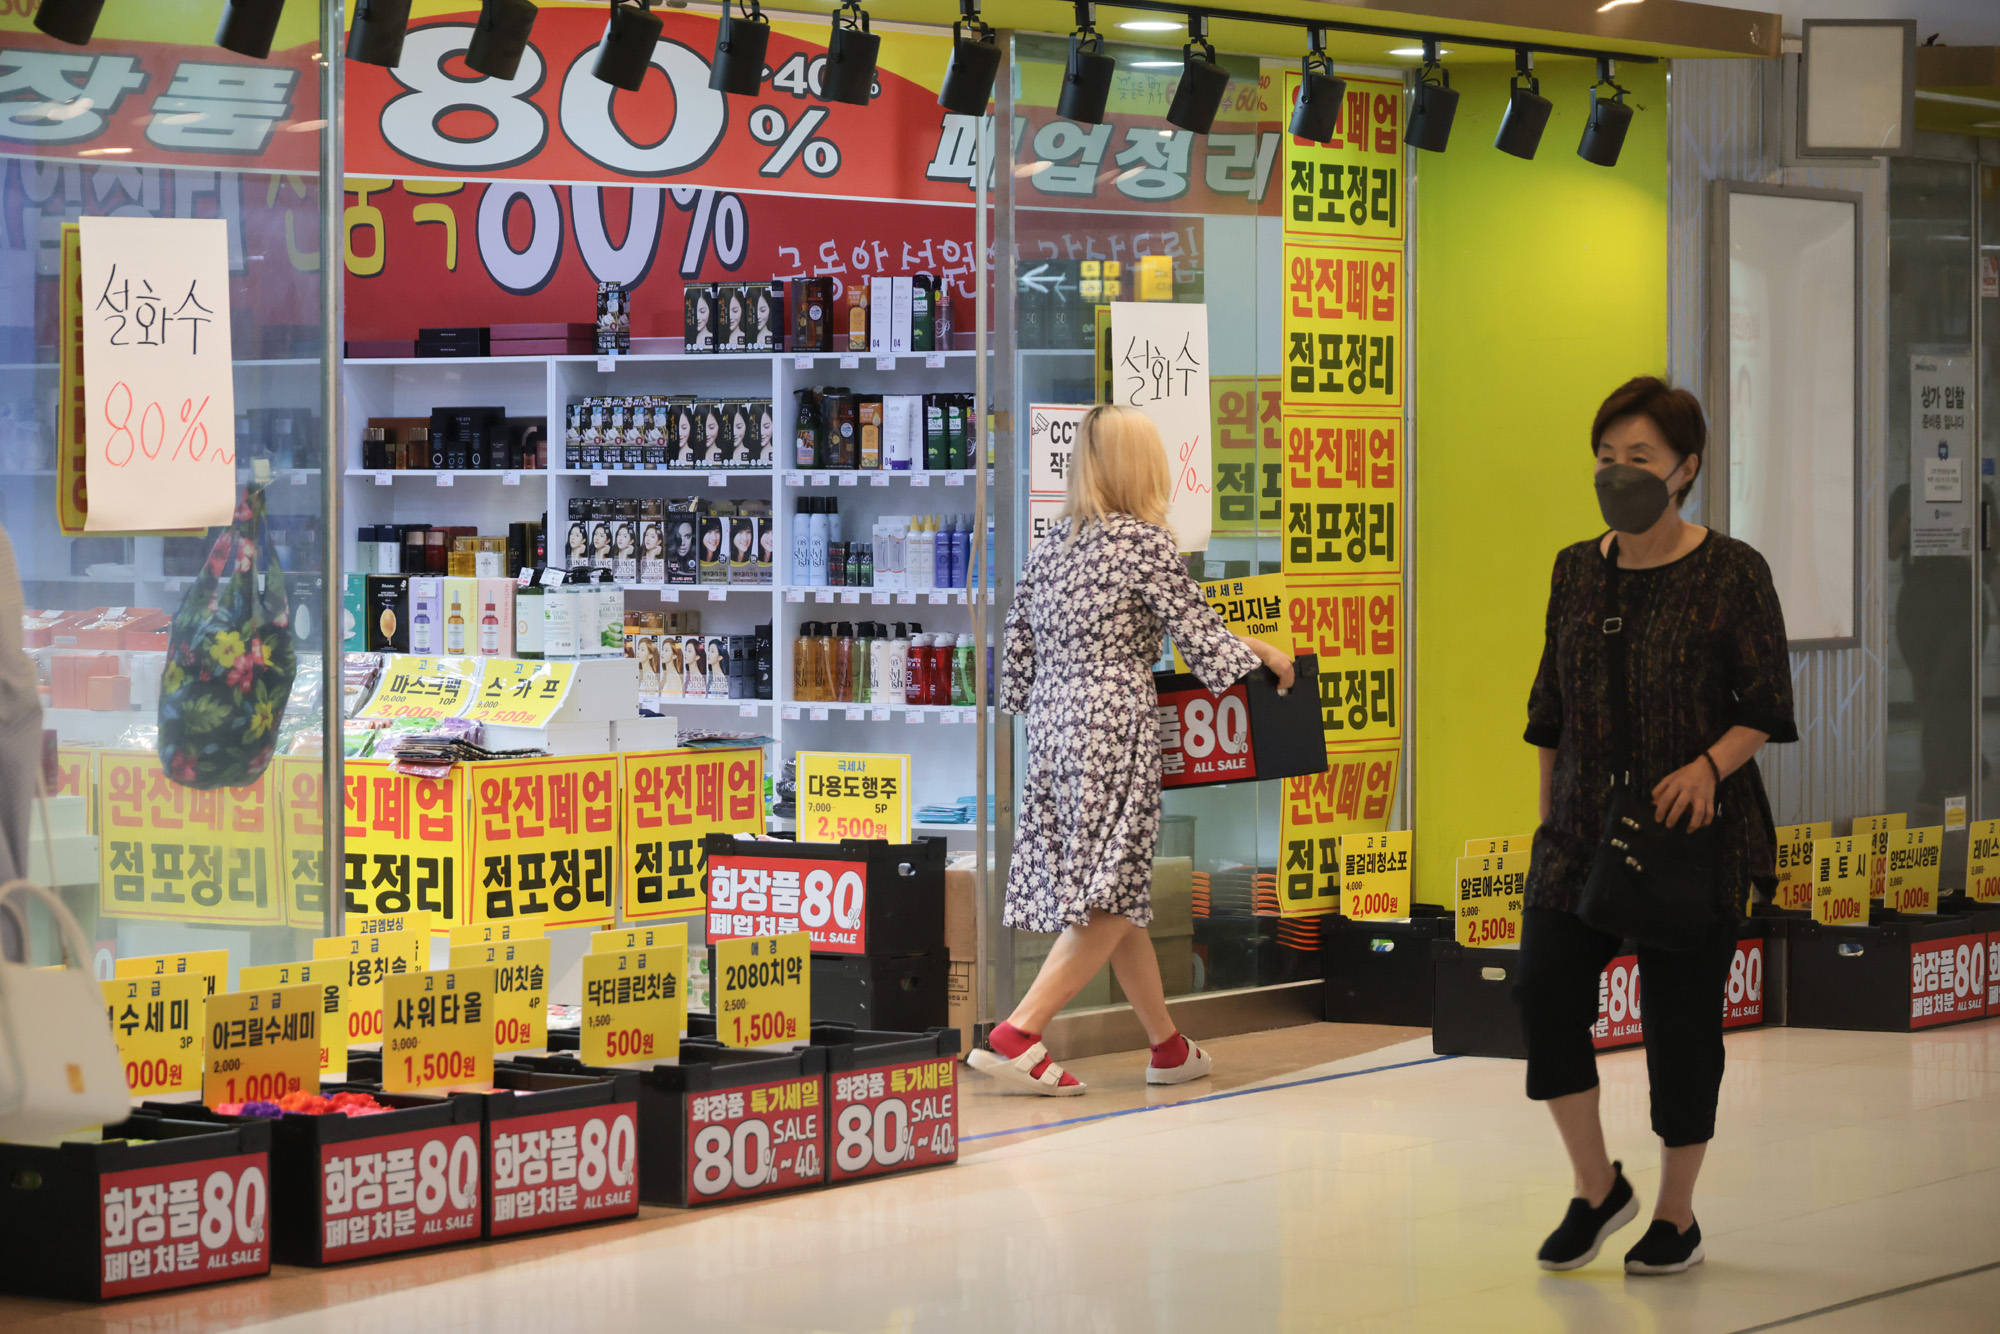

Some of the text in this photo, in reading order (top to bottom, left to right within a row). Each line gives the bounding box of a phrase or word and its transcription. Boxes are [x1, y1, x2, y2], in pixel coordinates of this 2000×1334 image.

[1291, 85, 1398, 154] 폐업
[926, 114, 1281, 203] 폐업정리
[1290, 161, 1396, 227] 점포정리
[1290, 256, 1395, 321] 완전폐업
[96, 264, 214, 354] 설화수
[873, 339, 880, 348] 04
[893, 339, 901, 347] 04
[1120, 331, 1200, 407] 설화수
[1289, 332, 1394, 394] 점포정리
[1921, 385, 1965, 409] 상가 입찰
[1944, 415, 1965, 430] 입니다
[1288, 427, 1394, 489] 완전폐업
[1288, 502, 1394, 563] 점포정리
[1205, 582, 1244, 599] 바세린
[1212, 595, 1282, 623] 오리지날
[1246, 621, 1279, 636] 100ml
[1289, 595, 1394, 657] 완전폐업
[390, 674, 462, 697] 마스크팩
[485, 677, 560, 699] 스카프
[1317, 668, 1395, 730] 포정리
[379, 694, 457, 706] 10,000 10P
[476, 700, 499, 709] 9,000
[474, 710, 537, 724] 2,500원
[1183, 694, 1249, 759] 80%
[837, 760, 866, 772] 극세사
[1193, 757, 1247, 774] ALL SALE
[108, 764, 265, 833] 완전폐업
[633, 760, 756, 829] 완전폐업
[808, 775, 898, 799] 다용도행주
[1289, 761, 1393, 826] 완전폐업
[480, 770, 613, 841] 완전폐업
[807, 802, 888, 814] 7,000 5P
[817, 816, 888, 840] 2,500원
[1794, 827, 1811, 839] 고급
[1872, 818, 1887, 830] 고급
[1907, 831, 1924, 844] 고급
[1367, 835, 1387, 848] 고급
[1489, 840, 1509, 853] 고급
[1835, 840, 1852, 853] 고급
[634, 837, 709, 904] 점포
[1286, 835, 1342, 900] 점포
[1345, 851, 1407, 876] 물걸레청소포
[1483, 857, 1503, 871] 고급
[1820, 853, 1866, 882] 쿨토시
[1890, 845, 1939, 871] 양모신사양말
[109, 841, 269, 908] 점포정리
[483, 845, 613, 918] 점포정리
[1345, 881, 1363, 891] 4,000
[1460, 872, 1524, 900] 알로에수딩젤
[710, 865, 864, 930] 화장품 80%
[1352, 892, 1398, 919] 2,000원
[1461, 900, 1522, 917] 5,000 99%
[1823, 897, 1861, 923] 1,000원
[1895, 887, 1929, 912] 1,000원
[360, 917, 404, 934] 고급엠보싱
[483, 925, 511, 942] 고급
[709, 912, 857, 945] 폐업처분 ALL SALE
[1468, 917, 1515, 945] 2,500원
[350, 938, 379, 954] 고급
[626, 931, 654, 948] 고급
[751, 940, 777, 956] 애경
[155, 958, 187, 974] 고급
[485, 946, 515, 962] 고급
[618, 953, 647, 970] 고급
[280, 966, 311, 984] 고급
[424, 974, 456, 991] 고급
[494, 963, 544, 994] 어칫솔
[726, 956, 802, 991] 2080치약
[1728, 947, 1762, 1004] 80%
[1912, 949, 1954, 994] 화장품
[127, 981, 161, 998] 고급
[249, 993, 281, 1011] 고급
[587, 972, 677, 1007] 닥터클린칫솔
[1608, 963, 1641, 1023] 80
[393, 991, 482, 1030] 샤워타올
[528, 997, 540, 1010] 4P
[724, 998, 747, 1012] 2,500
[1731, 1005, 1760, 1018] ALL SALE
[1912, 991, 1982, 1018] 폐업처분 ALL SALE
[109, 999, 189, 1036] 수세미
[213, 1012, 315, 1050] 아크릴수세미
[588, 1014, 612, 1028] 1,500
[733, 1010, 797, 1048] 1,500원
[180, 1037, 193, 1049] 3P
[391, 1037, 418, 1051] 3,000
[606, 1028, 654, 1058] 500원
[1612, 1026, 1625, 1037] ALL
[213, 1058, 241, 1074] 2,000
[403, 1050, 476, 1087] 1,500원
[226, 1072, 301, 1104] 1,000원
[835, 1060, 954, 1102] 화장품 특가세일
[692, 1080, 819, 1123] 화장품 특가세일
[911, 1094, 952, 1123] SALE
[773, 1114, 817, 1145] SALE
[494, 1114, 635, 1191] 화장품 80%
[325, 1135, 478, 1215] 화장품 80%
[104, 1166, 266, 1250] 화장품 80%
[494, 1183, 631, 1222] 폐업처분 ALL SALE
[325, 1207, 474, 1249] 폐업처분 ALL SALE
[104, 1240, 261, 1283] 폐업처분 ALL SALE
